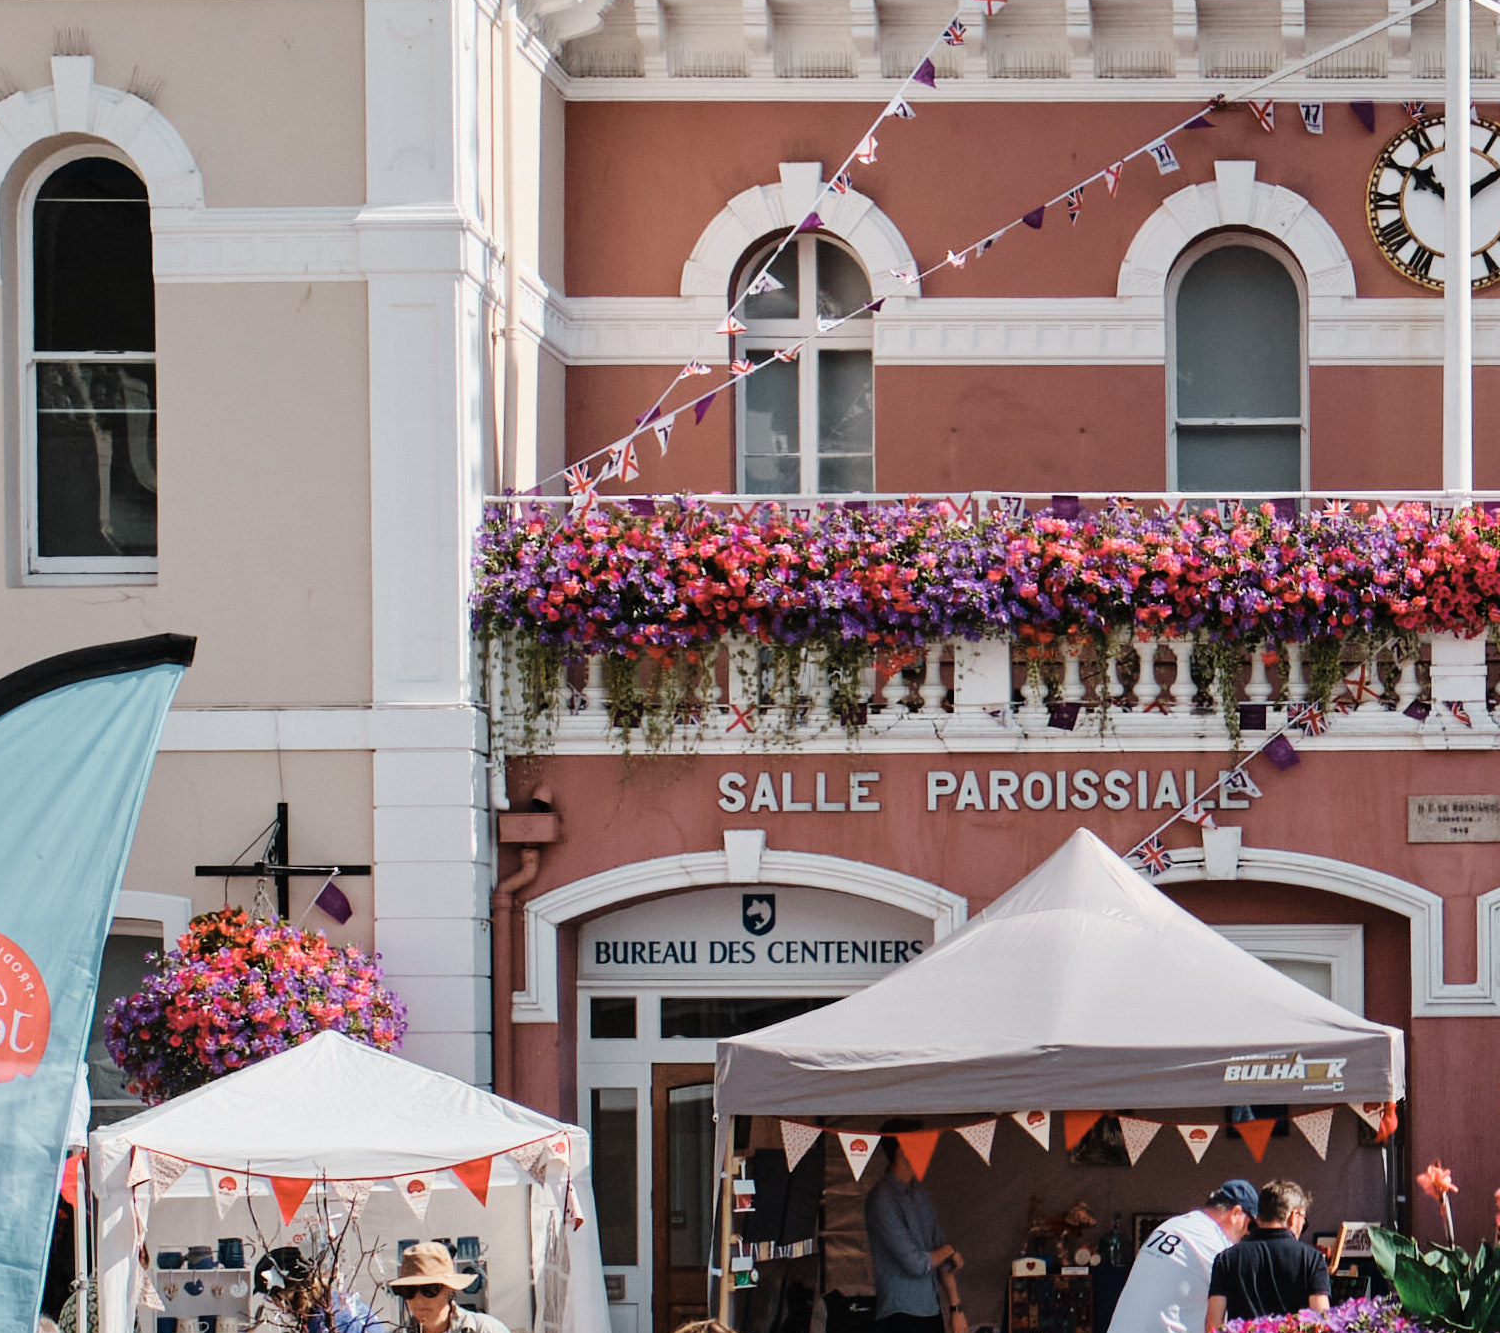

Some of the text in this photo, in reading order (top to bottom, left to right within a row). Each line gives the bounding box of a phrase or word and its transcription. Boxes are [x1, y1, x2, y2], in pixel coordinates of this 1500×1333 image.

[718, 769, 1251, 813] SALLE PAROISSIALE
[595, 940, 924, 964] BUREAU DES CENTENIERS
[1224, 1057, 1347, 1081] BULHAK
[1147, 1230, 1182, 1255] 78
